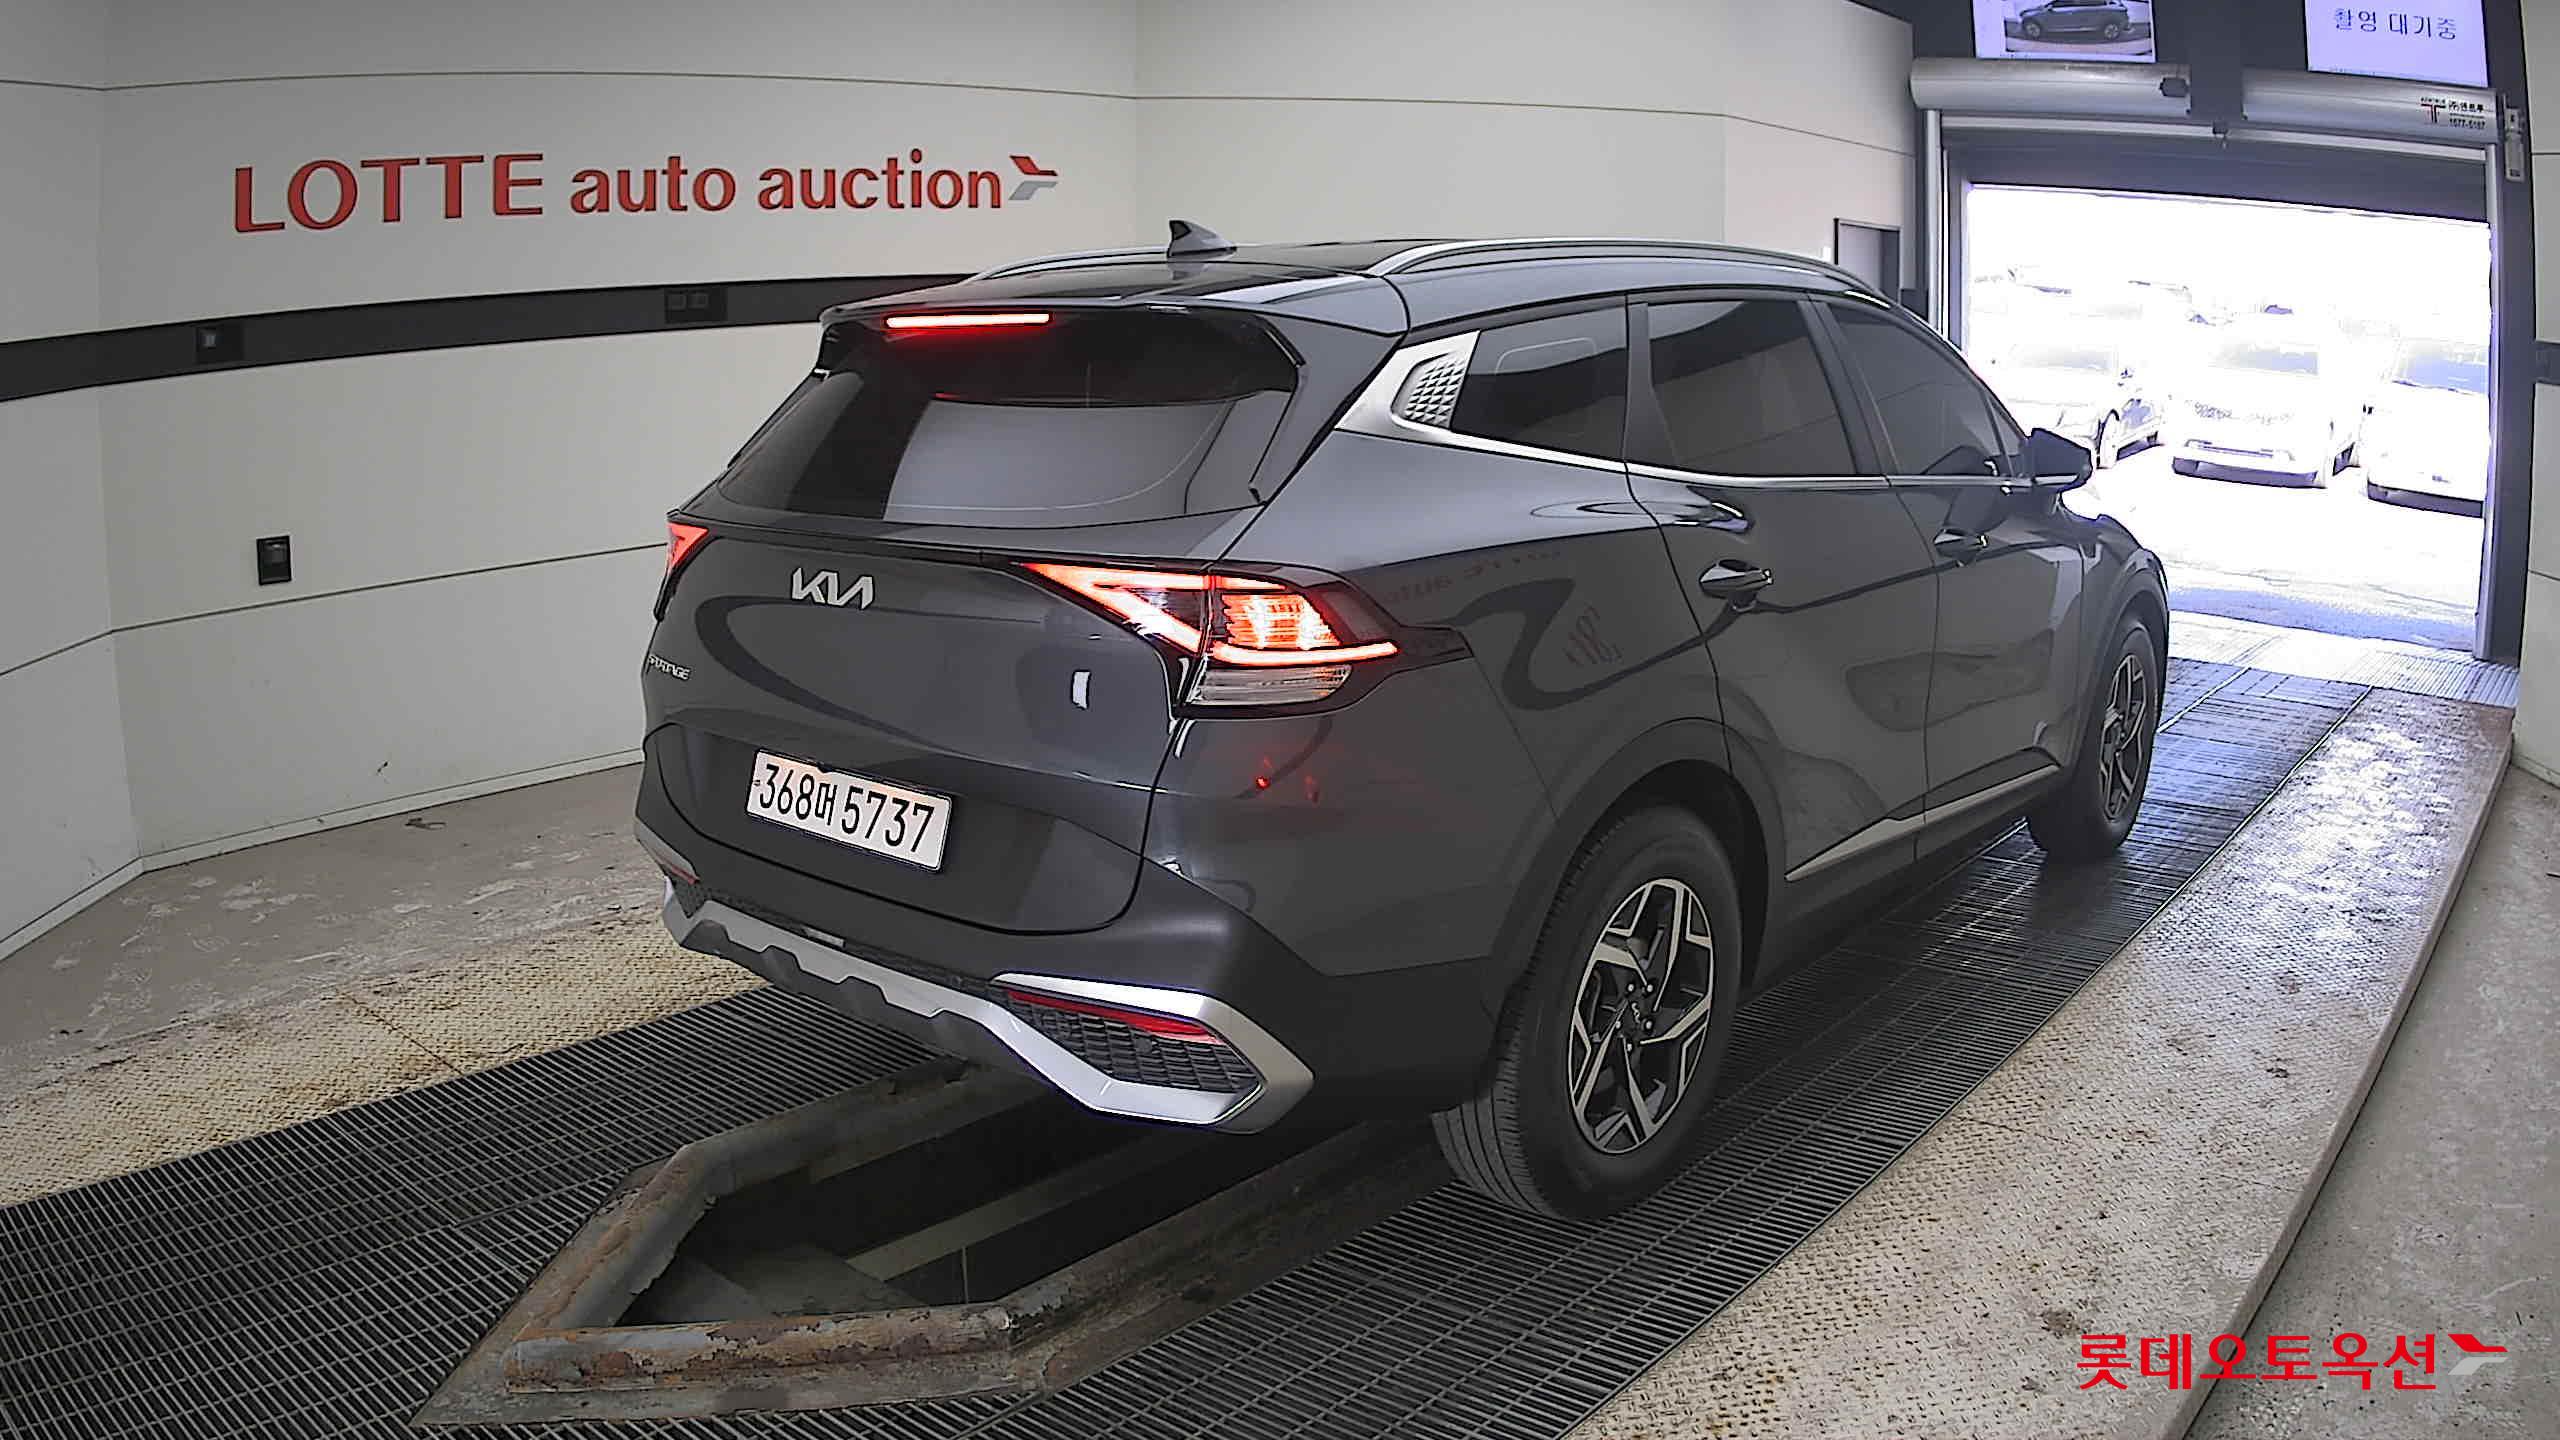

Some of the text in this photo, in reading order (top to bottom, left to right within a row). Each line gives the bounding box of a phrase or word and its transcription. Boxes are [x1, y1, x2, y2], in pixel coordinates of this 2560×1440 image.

[2389, 13, 2457, 41] 대기중
[234, 148, 1003, 233] LOTTE auto auction
[791, 567, 875, 610] KIA
[759, 763, 935, 853] 368머 5737
